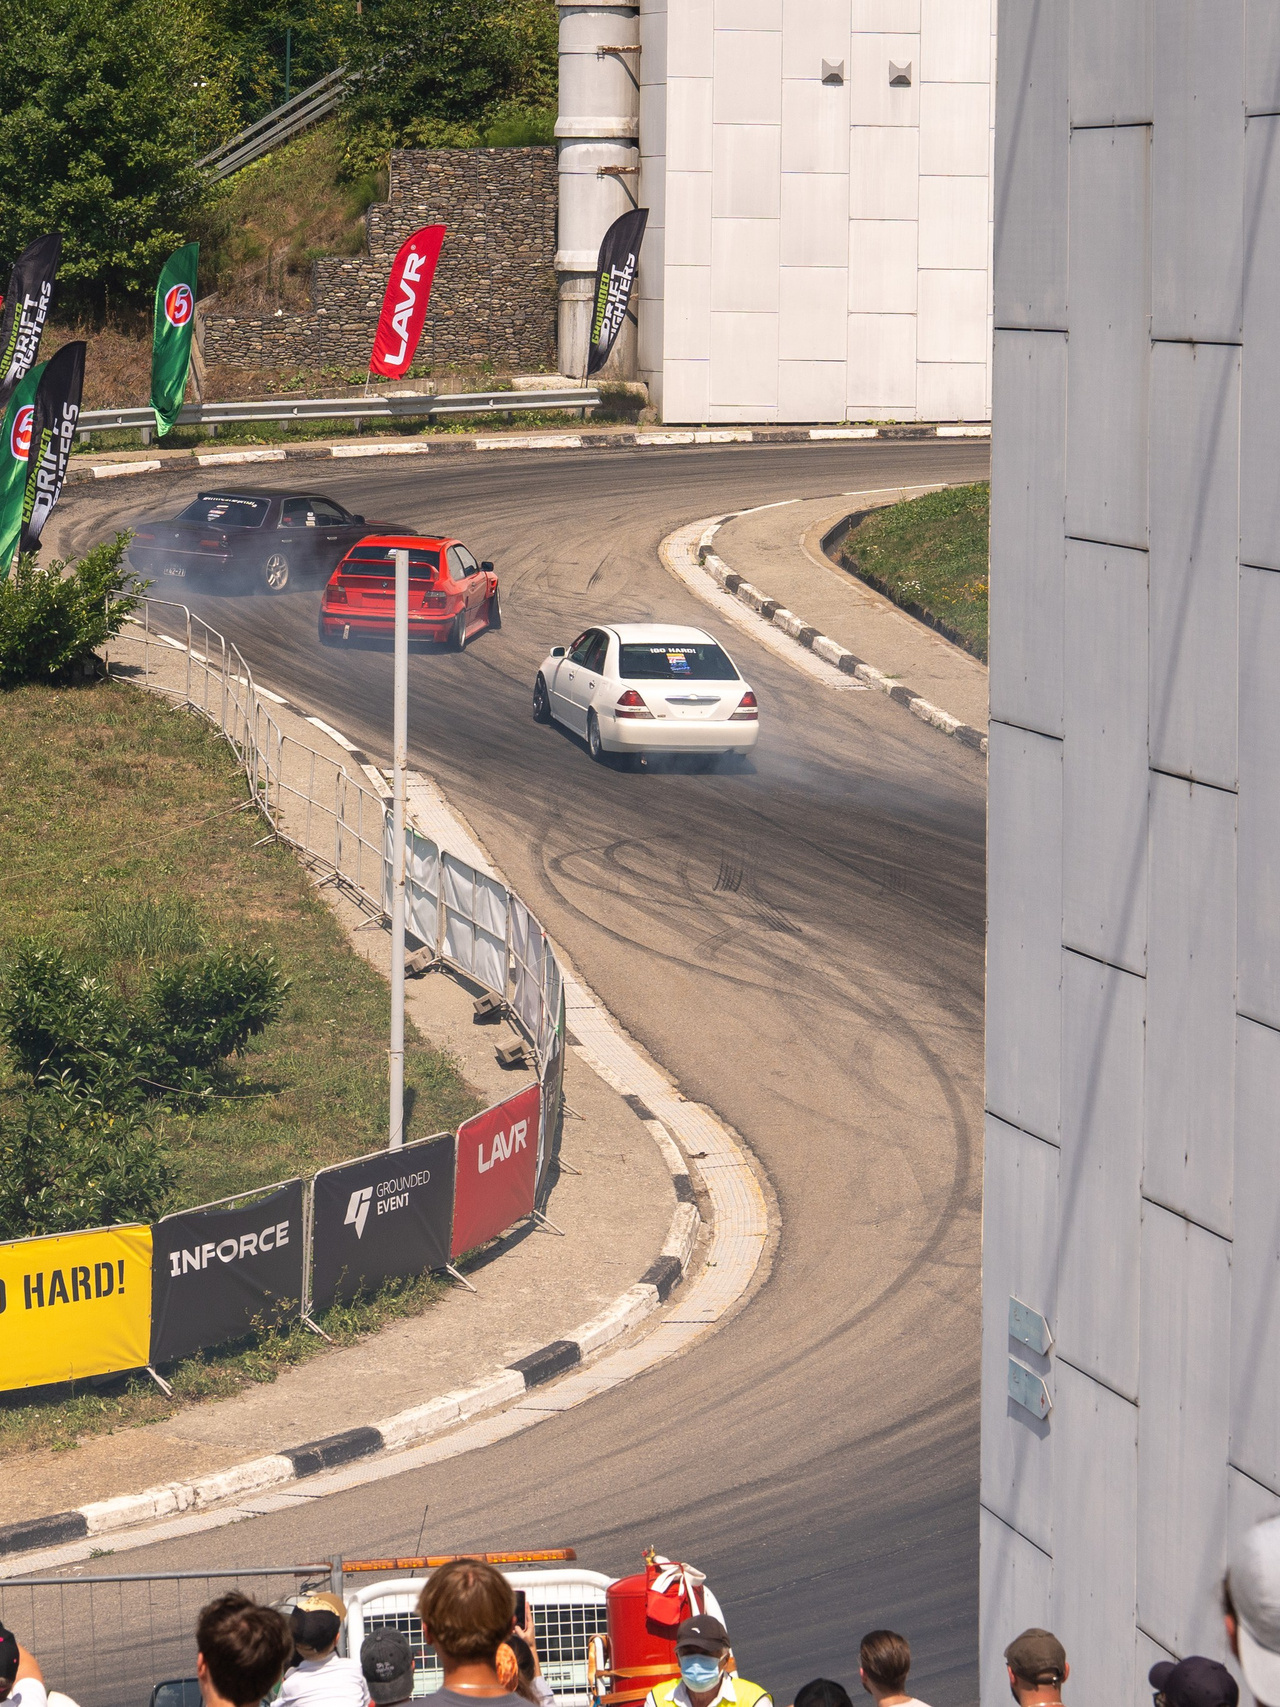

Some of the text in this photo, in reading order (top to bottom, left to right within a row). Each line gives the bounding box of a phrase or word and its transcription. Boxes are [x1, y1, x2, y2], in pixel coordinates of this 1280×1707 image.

[600, 264, 625, 354] DRIFT
[376, 1169, 431, 1198] GROUNDED
[377, 1191, 410, 1216] EVENT
[169, 1219, 290, 1278] INFORCE
[23, 1260, 126, 1310] HARD!
